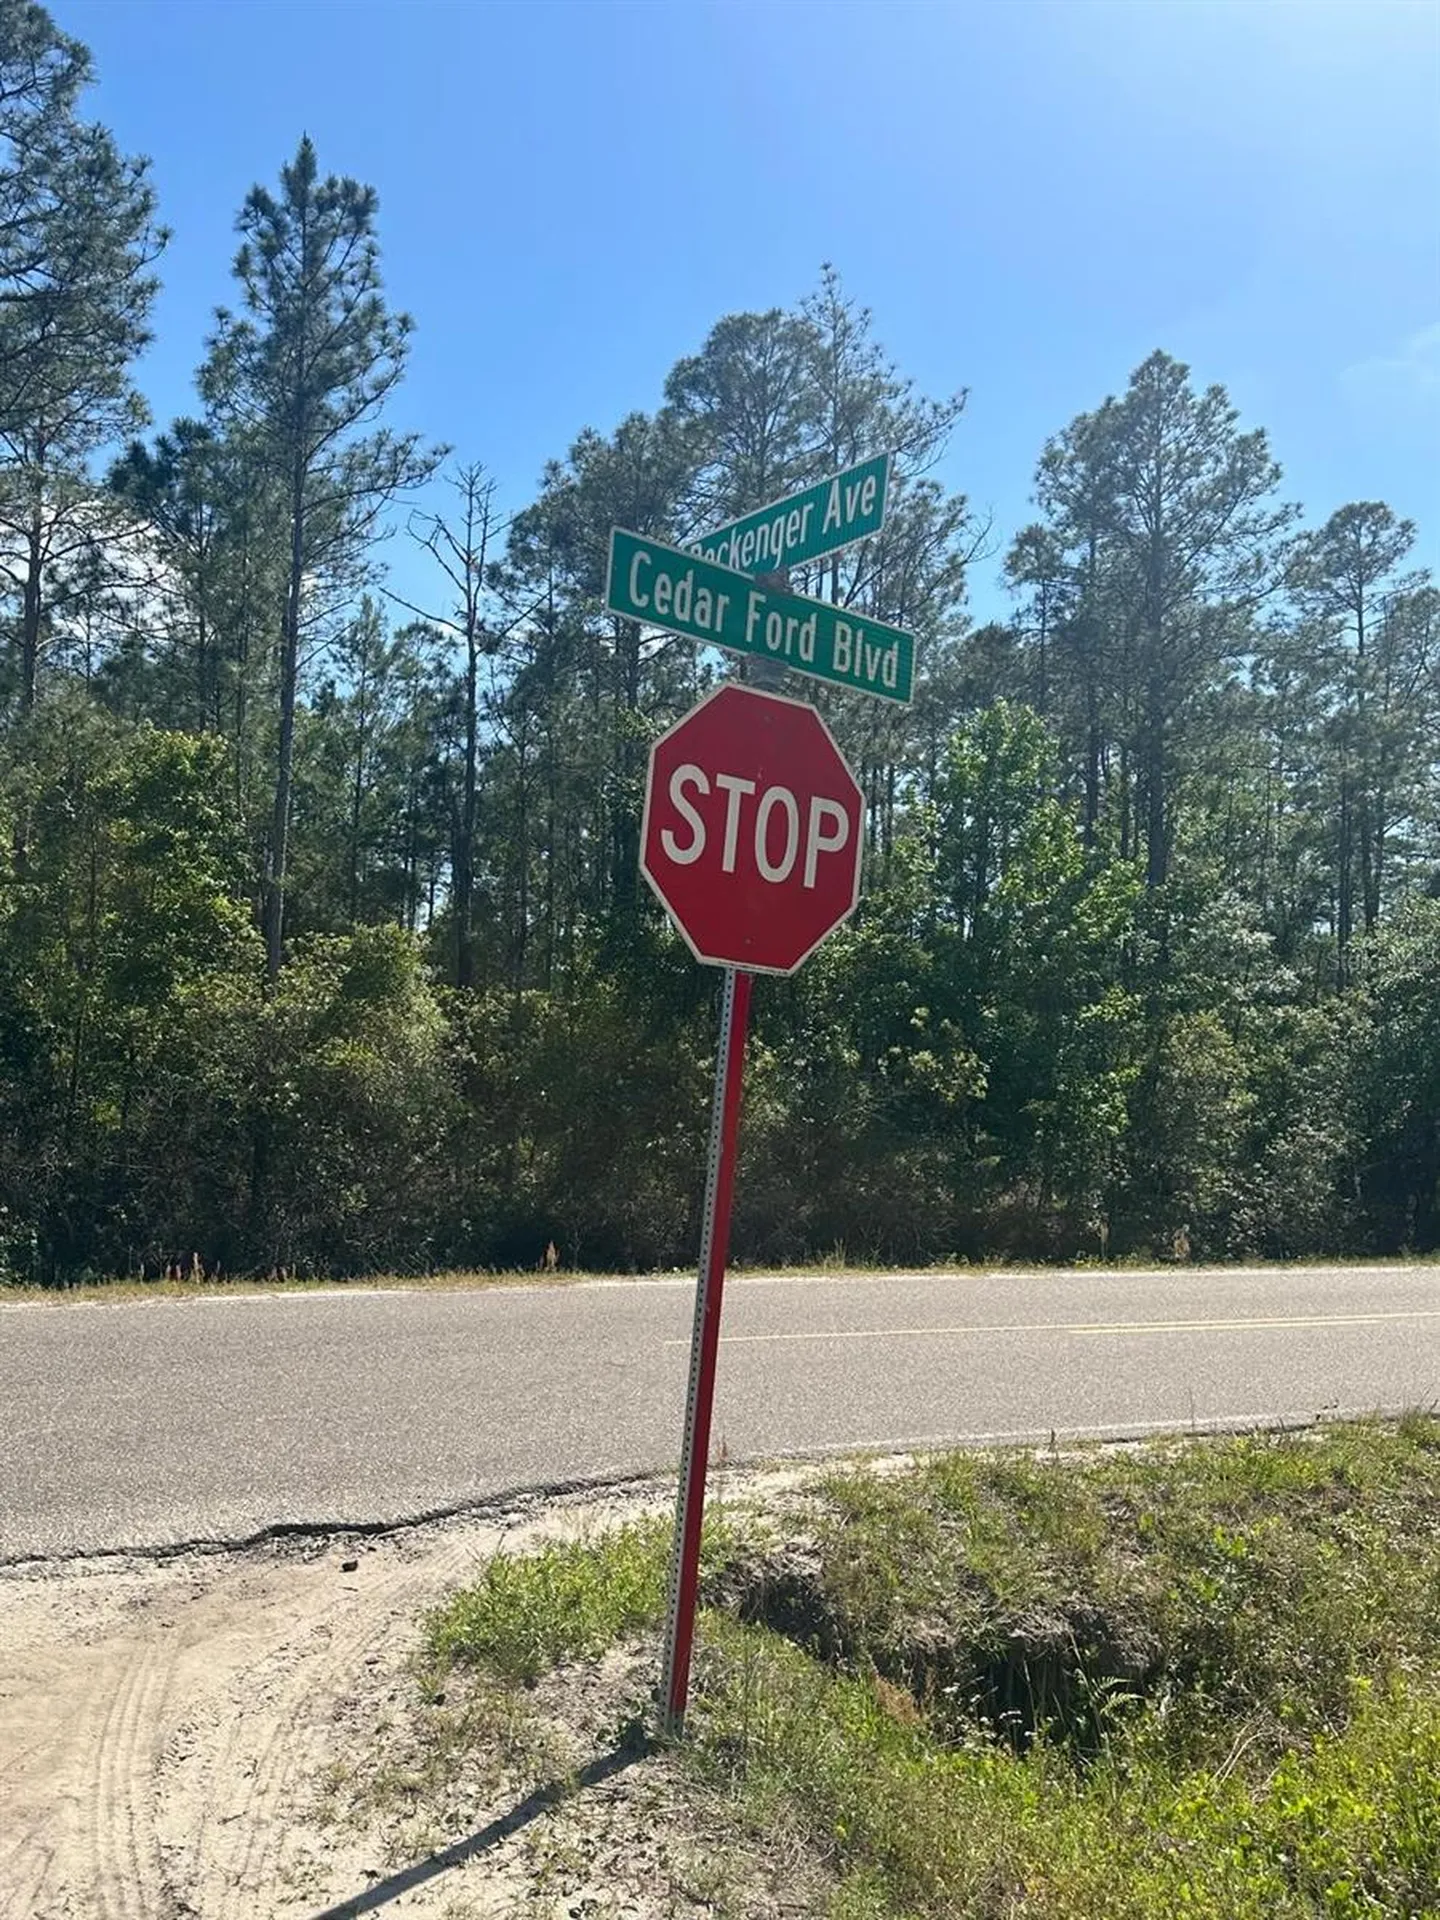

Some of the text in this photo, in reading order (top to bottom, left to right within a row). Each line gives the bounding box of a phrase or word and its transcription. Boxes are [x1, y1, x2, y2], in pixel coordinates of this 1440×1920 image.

[822, 474, 876, 533] Ave
[629, 550, 900, 689] Cedar Ford Blvd
[660, 763, 850, 889] STOP
